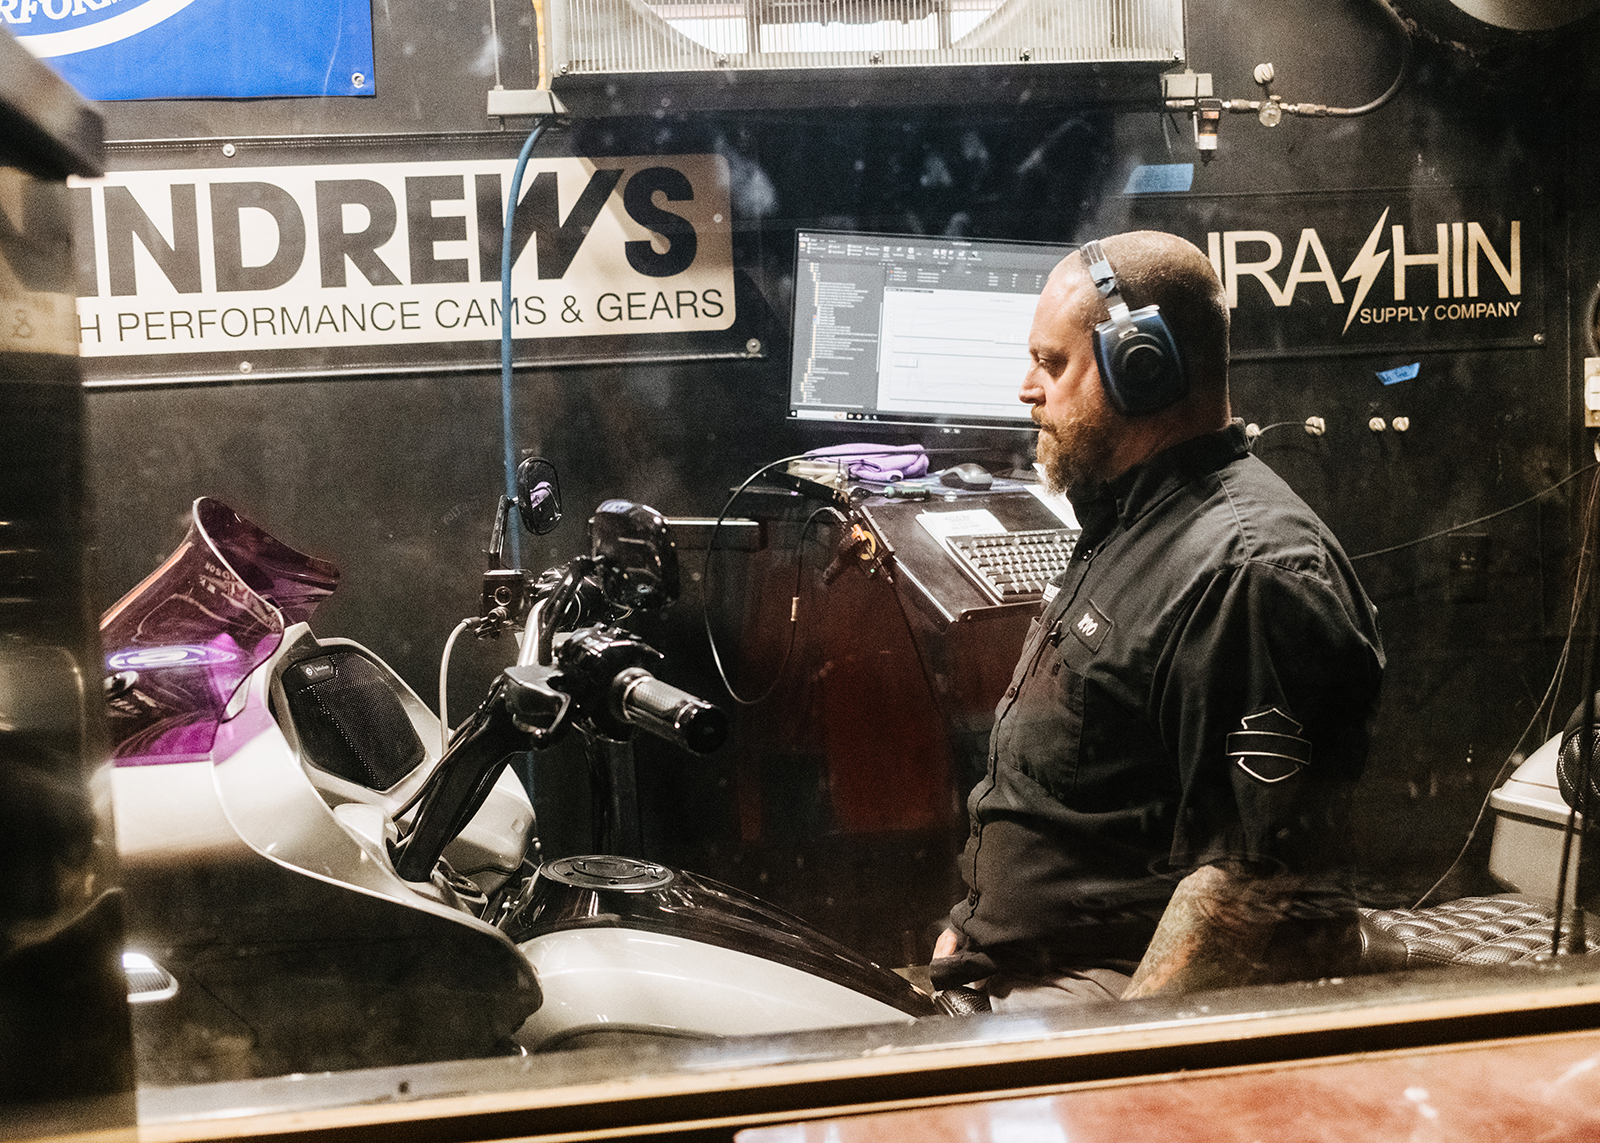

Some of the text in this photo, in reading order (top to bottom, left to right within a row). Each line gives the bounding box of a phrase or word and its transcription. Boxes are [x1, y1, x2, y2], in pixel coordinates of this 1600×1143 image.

[117, 301, 420, 342] PERFORMANCE
[435, 296, 547, 328] CAMS
[560, 295, 584, 323] &
[596, 289, 725, 322] GEARS
[1359, 301, 1522, 324] SUPPLY COMPANY
